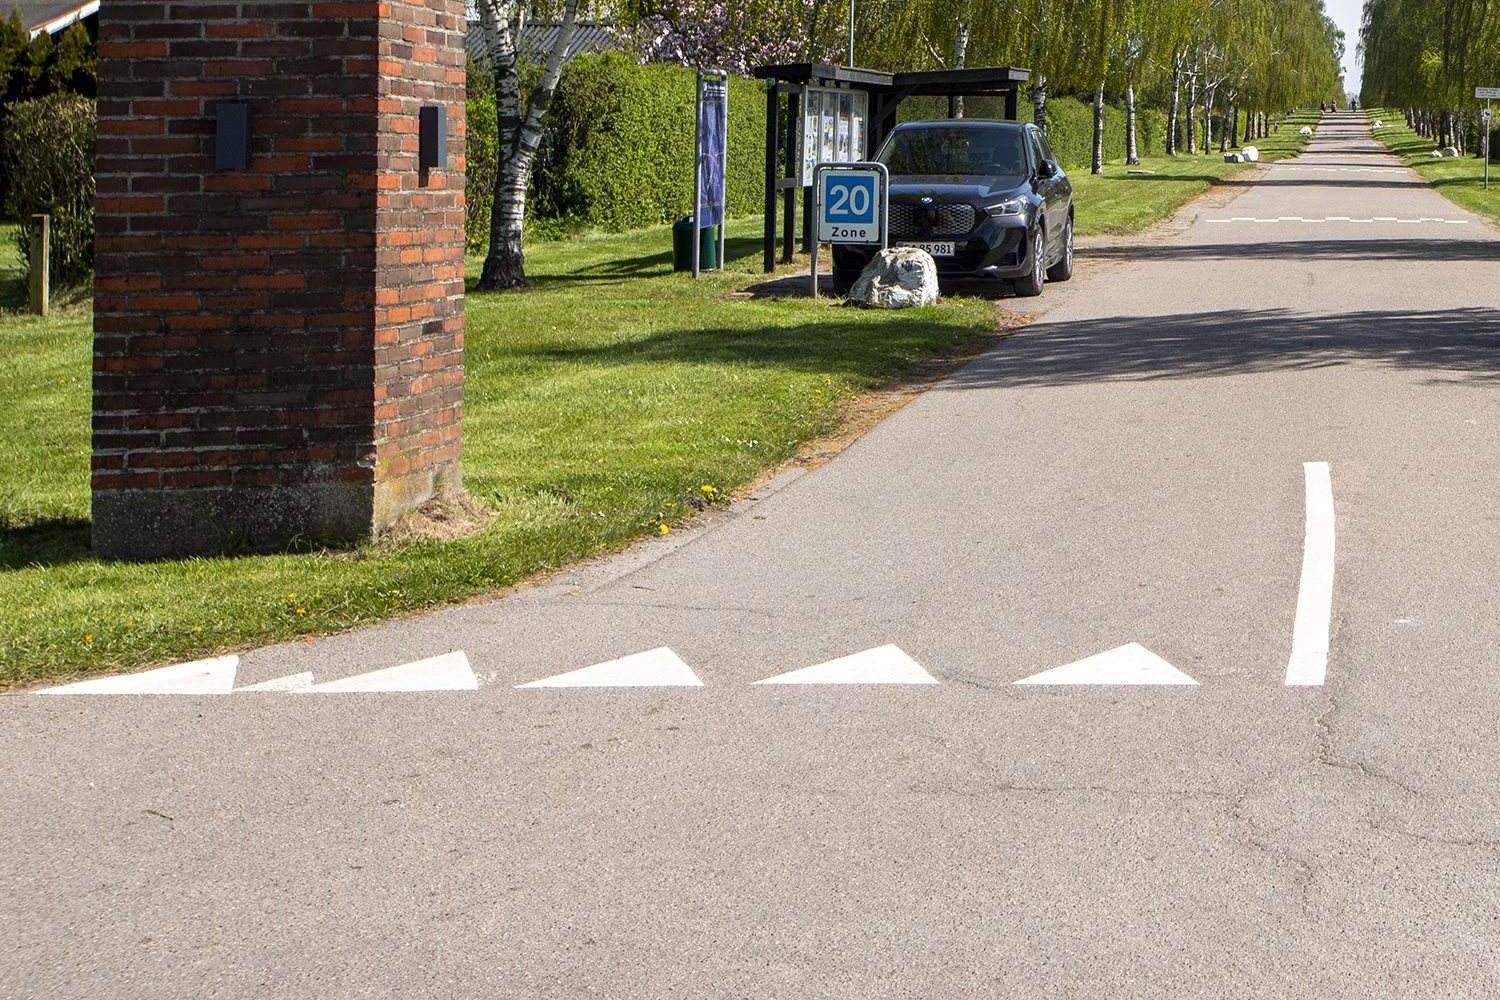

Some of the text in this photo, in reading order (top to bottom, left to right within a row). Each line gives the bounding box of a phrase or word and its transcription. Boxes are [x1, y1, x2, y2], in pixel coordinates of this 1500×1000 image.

[829, 184, 870, 216] 20
[831, 226, 867, 238] Zone
[934, 244, 951, 254] 981
